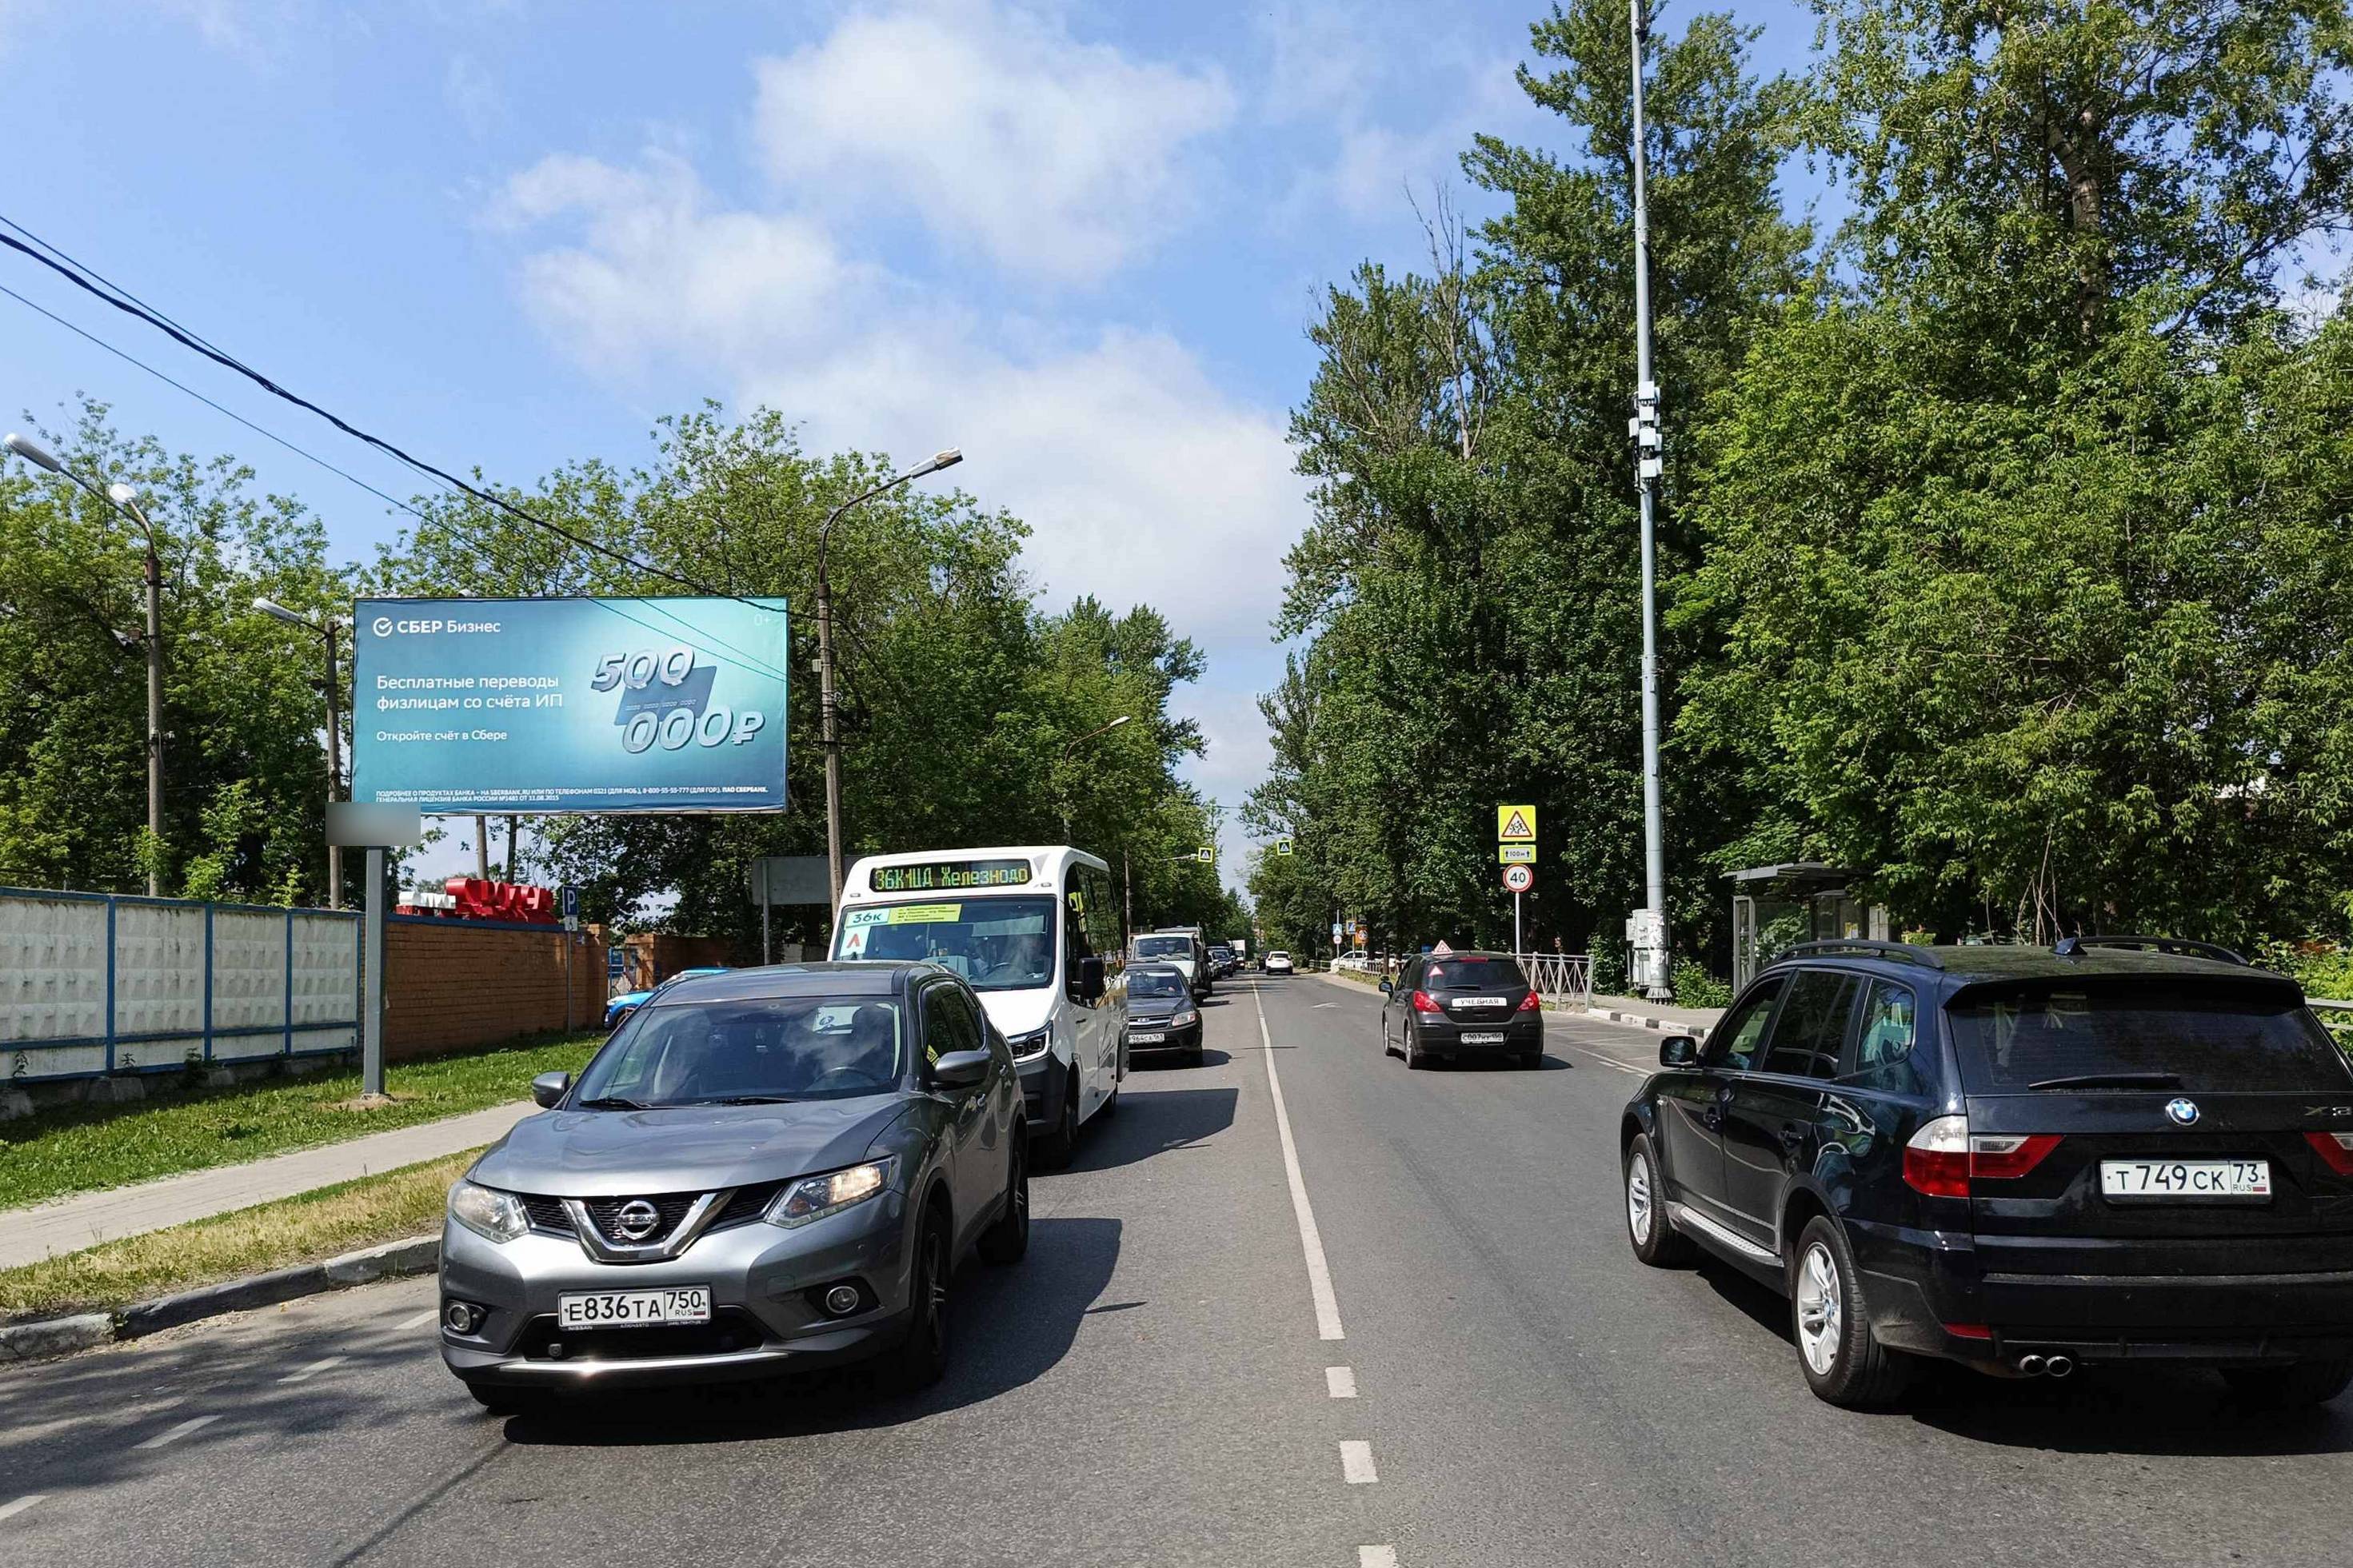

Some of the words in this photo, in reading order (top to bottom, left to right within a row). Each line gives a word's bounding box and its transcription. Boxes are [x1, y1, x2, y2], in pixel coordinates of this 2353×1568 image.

[397, 620, 443, 633] СБЕР
[447, 620, 501, 633] Бизнес
[591, 645, 695, 692] 500
[377, 675, 475, 689] Бесплатные
[479, 676, 559, 691] переводы
[377, 695, 459, 712] физлицам
[463, 698, 482, 709] со
[486, 694, 531, 708] счёта
[535, 693, 563, 708] ИП
[376, 730, 433, 743] Откройте
[434, 729, 459, 741] счёт
[461, 732, 469, 740] в
[471, 729, 508, 742] Сбере
[1509, 871, 1526, 884] 40
[2232, 1163, 2259, 1183] 73
[2232, 1183, 2252, 1192] RUS
[665, 1291, 702, 1310] 750
